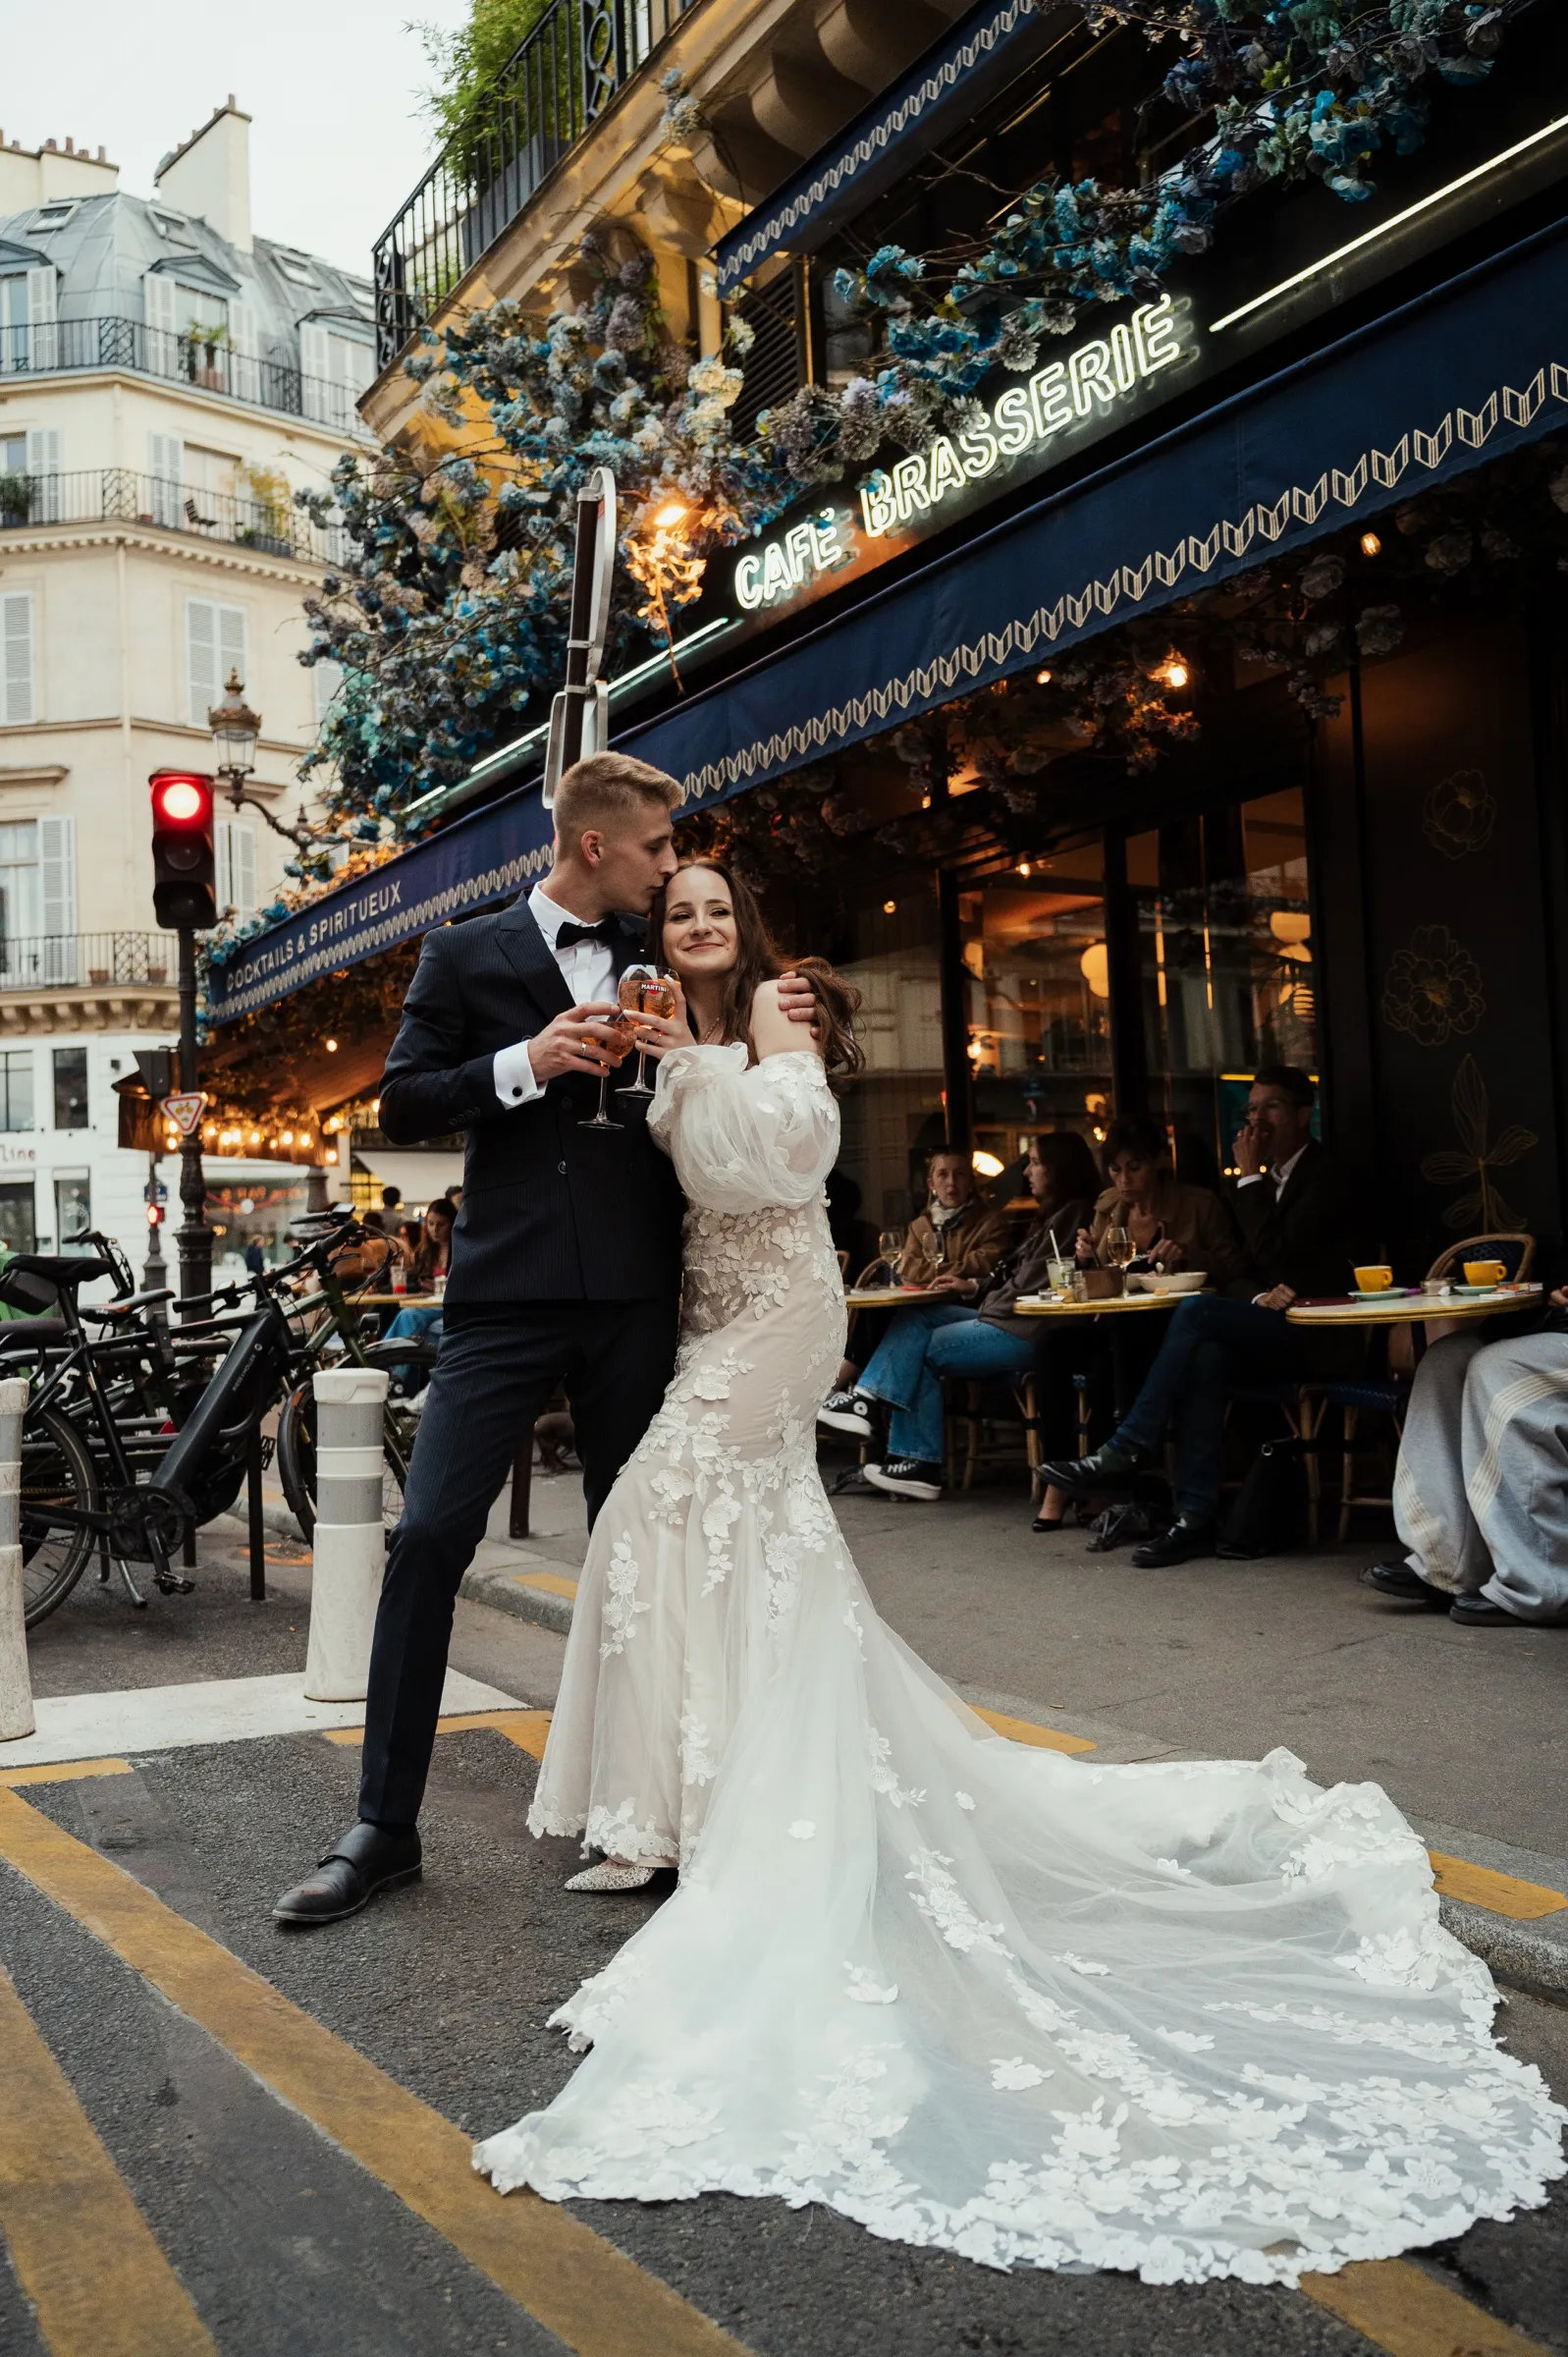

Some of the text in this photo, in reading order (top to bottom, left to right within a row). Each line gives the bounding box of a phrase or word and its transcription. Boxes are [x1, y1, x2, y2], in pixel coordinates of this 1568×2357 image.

[860, 294, 1180, 538] BRASSERIE
[227, 880, 402, 992] COCKTAILS & SPIRITUEUX
[640, 983, 667, 992] MARTINI
